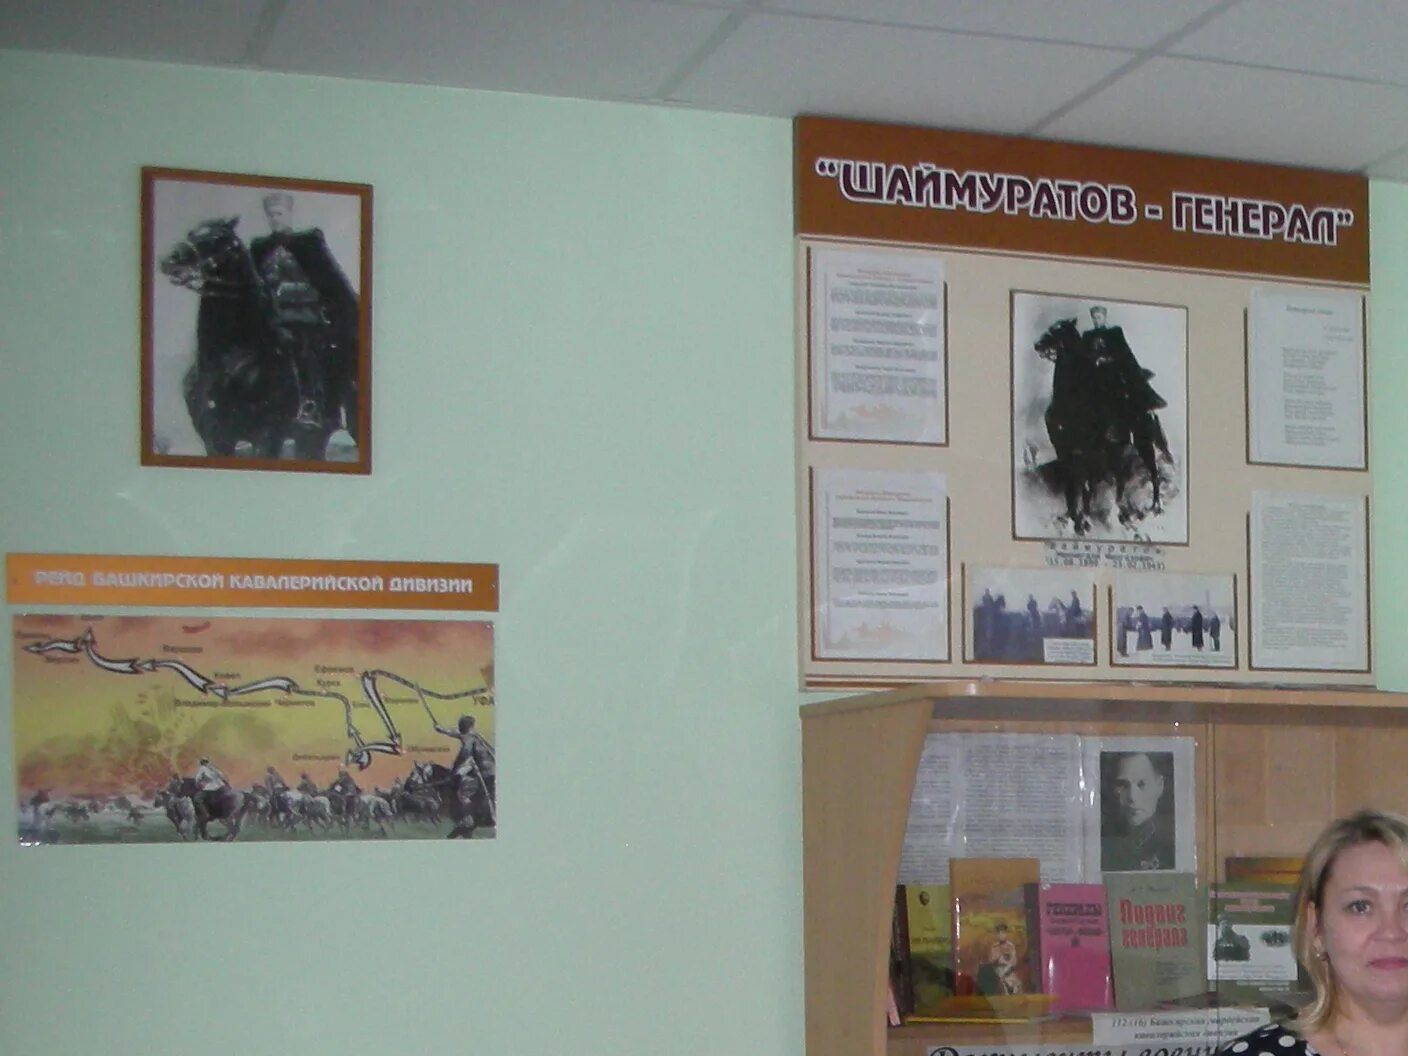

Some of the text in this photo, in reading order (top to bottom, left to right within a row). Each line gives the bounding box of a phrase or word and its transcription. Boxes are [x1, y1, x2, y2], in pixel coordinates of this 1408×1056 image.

[1145, 204, 1162, 220] -
[92, 571, 225, 589] БАШКИРСКОЙ
[230, 574, 384, 592] КАВАЛЕРИЙСКОЙ
[389, 576, 474, 594] ДИВИЗИИ
